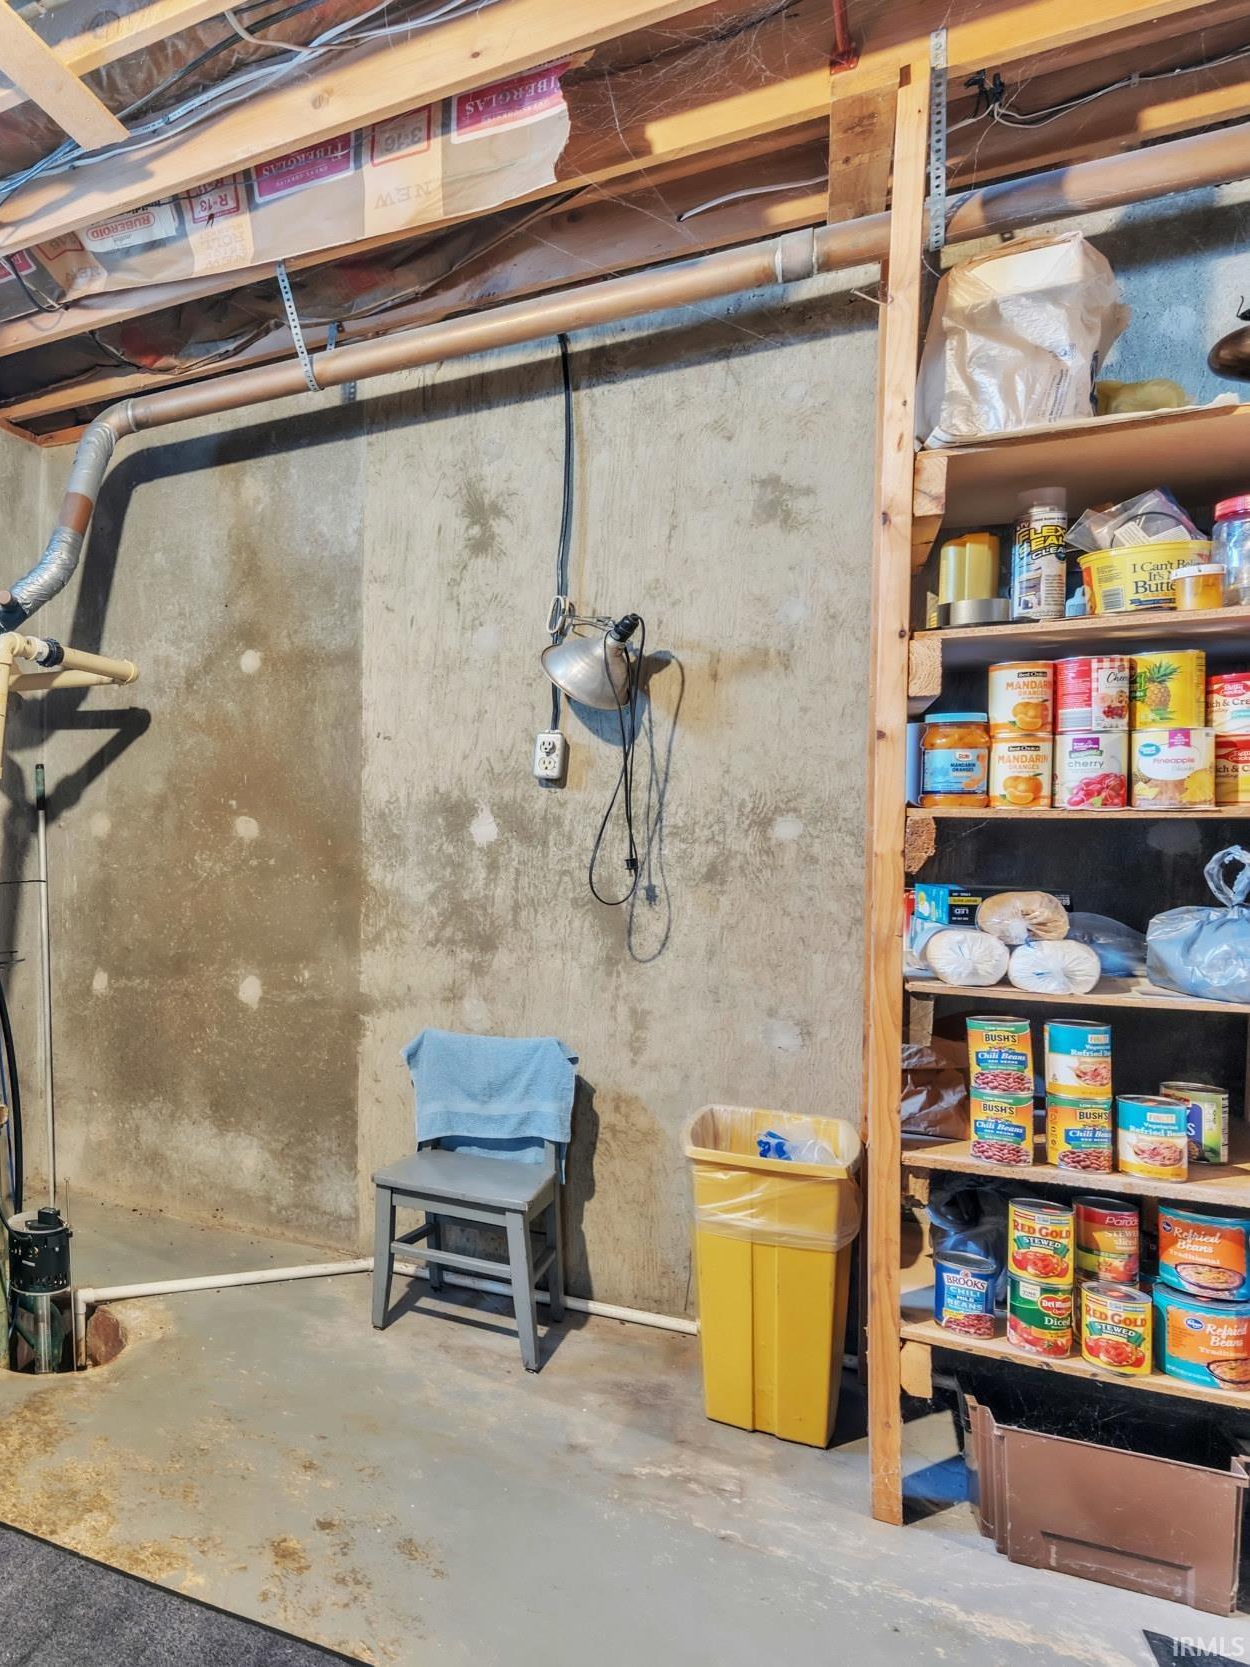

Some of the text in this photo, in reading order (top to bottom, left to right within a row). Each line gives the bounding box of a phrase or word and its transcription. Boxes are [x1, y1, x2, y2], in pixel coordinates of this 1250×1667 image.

[262, 139, 344, 178] FIBERGLAS
[91, 212, 151, 238] RUBEROID
[1017, 525, 1066, 545] FLEX
[1032, 547, 1066, 560] CLEA
[1141, 560, 1174, 573] Can't
[1149, 571, 1165, 582] It's
[997, 754, 1048, 765] MANDARIN
[1067, 760, 1104, 769] cherry
[978, 1052, 1026, 1061] Chili Beans
[976, 1120, 1023, 1134] Chili Beans
[1069, 1130, 1093, 1138] Chili
[1013, 1220, 1036, 1235] RED
[1173, 1226, 1222, 1244] Refried
[1023, 1236, 1062, 1249] STEWED
[1176, 1239, 1214, 1254] Beans
[946, 1275, 986, 1291] BROOKS
[950, 1287, 980, 1298] CHILI
[947, 1298, 983, 1310] BEANS
[1084, 1303, 1147, 1328] RED GOLD
[1095, 1322, 1136, 1338] STEWED
[1205, 1322, 1248, 1336] Refried
[1210, 1335, 1244, 1347] Beans
